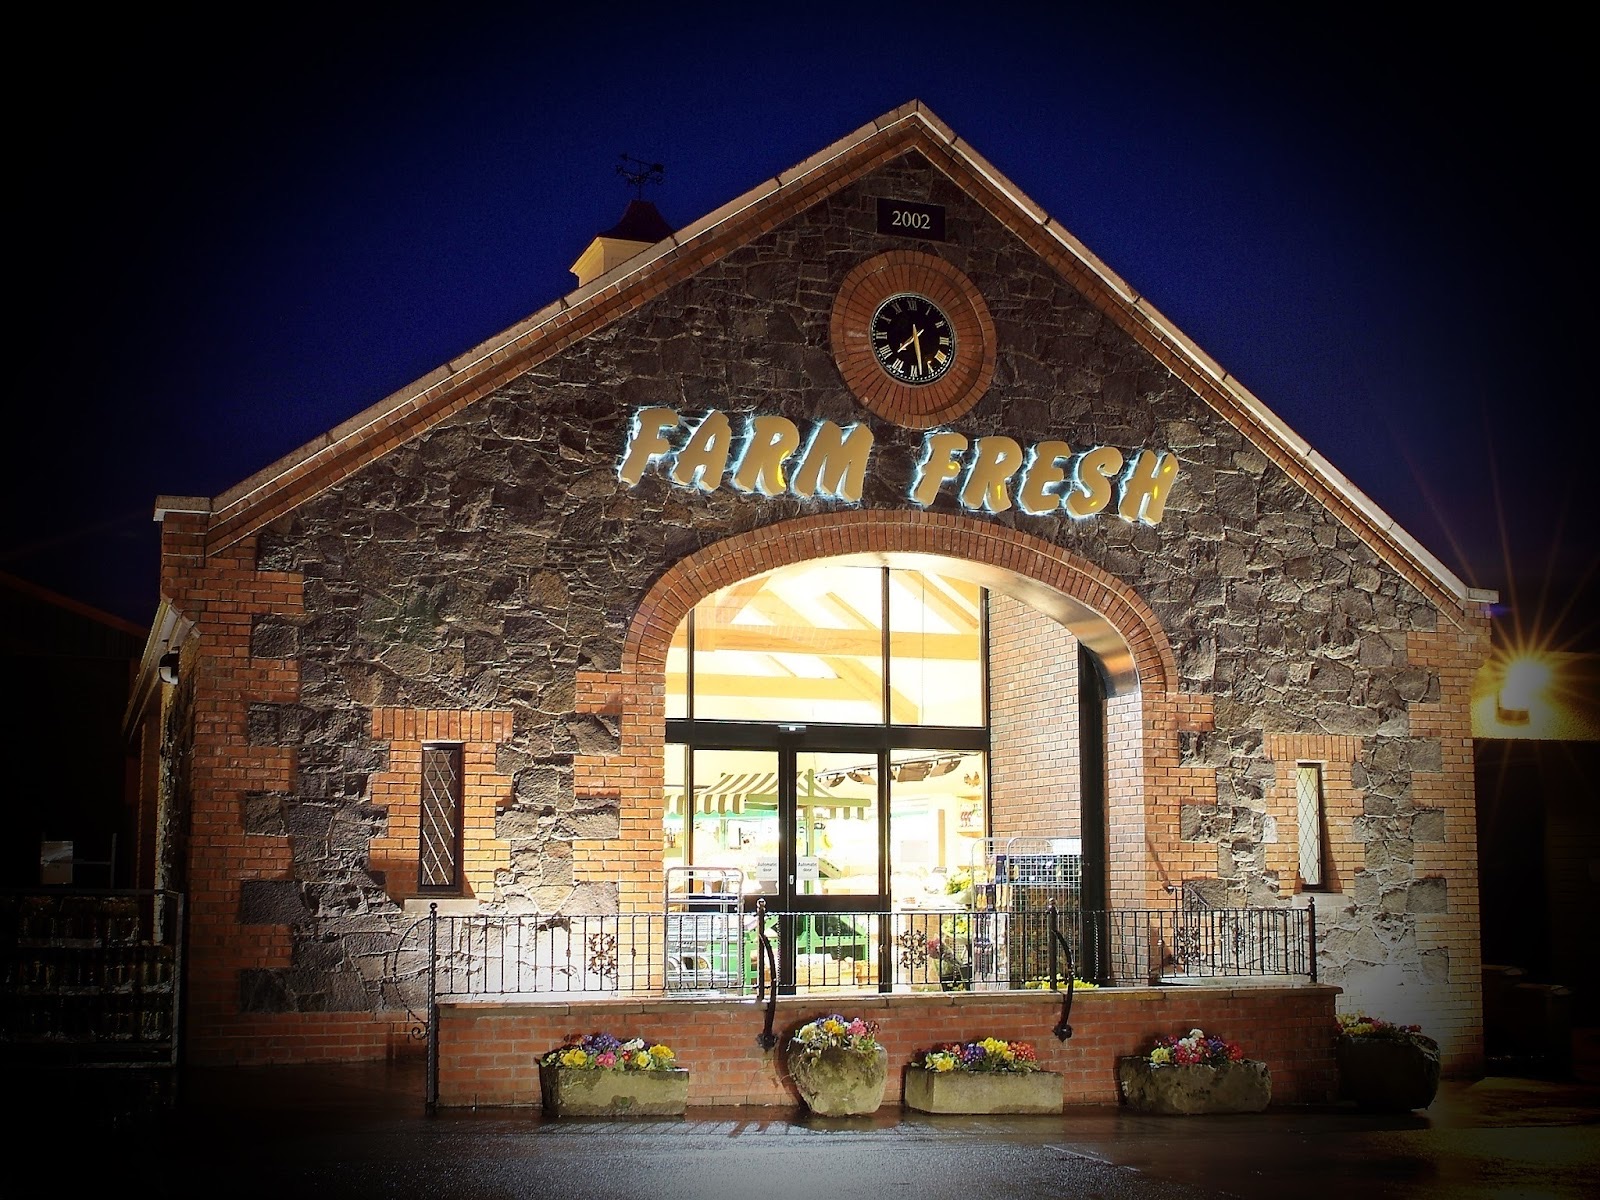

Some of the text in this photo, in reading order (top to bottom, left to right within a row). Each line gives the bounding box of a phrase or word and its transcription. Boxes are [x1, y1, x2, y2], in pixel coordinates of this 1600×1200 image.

[891, 210, 931, 230] 2002
[617, 406, 1180, 527] FARM FRESH
